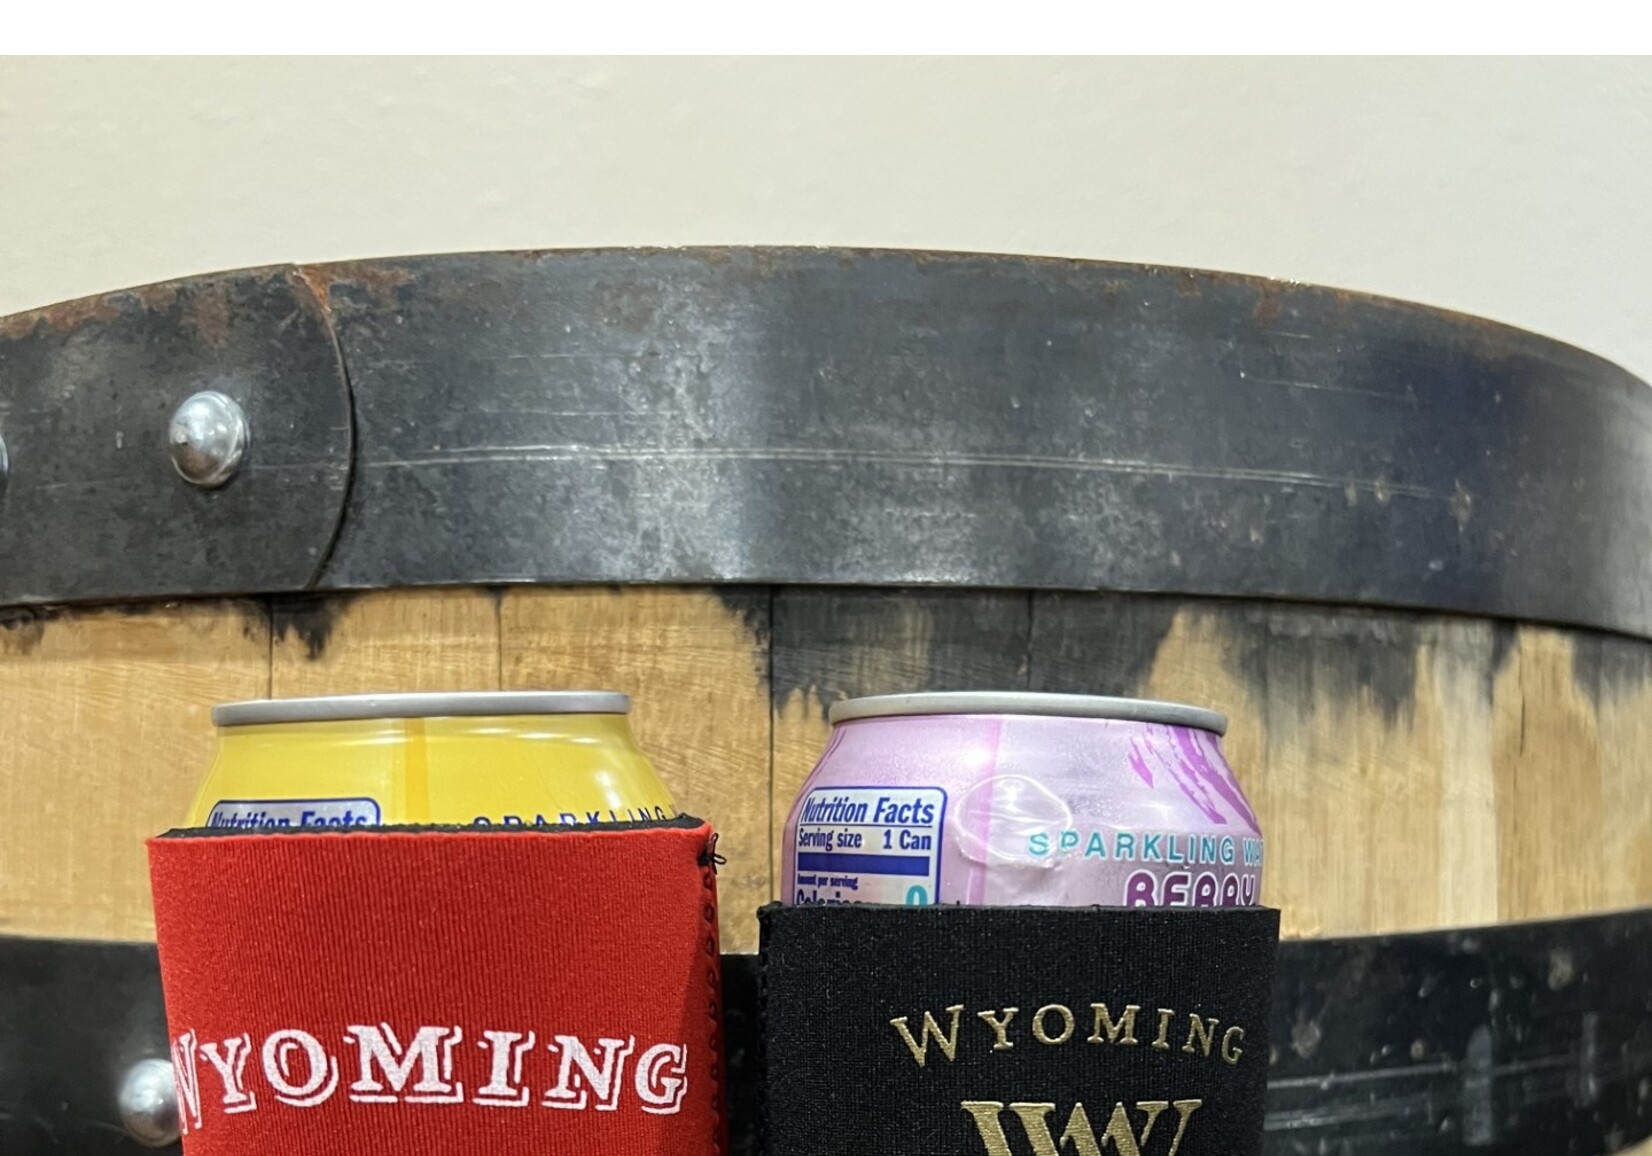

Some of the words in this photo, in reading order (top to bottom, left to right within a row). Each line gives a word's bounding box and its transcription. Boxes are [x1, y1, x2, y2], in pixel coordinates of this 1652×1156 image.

[801, 796, 868, 823] Nutrition
[873, 797, 935, 824] Facts
[799, 828, 834, 851] Serving
[837, 829, 862, 848] size
[883, 829, 892, 849] 1
[899, 830, 931, 850] Can
[1029, 831, 1235, 864] SPARKLING
[890, 1003, 1245, 1067] WYOMING
[172, 1021, 688, 1135] WYOMING
